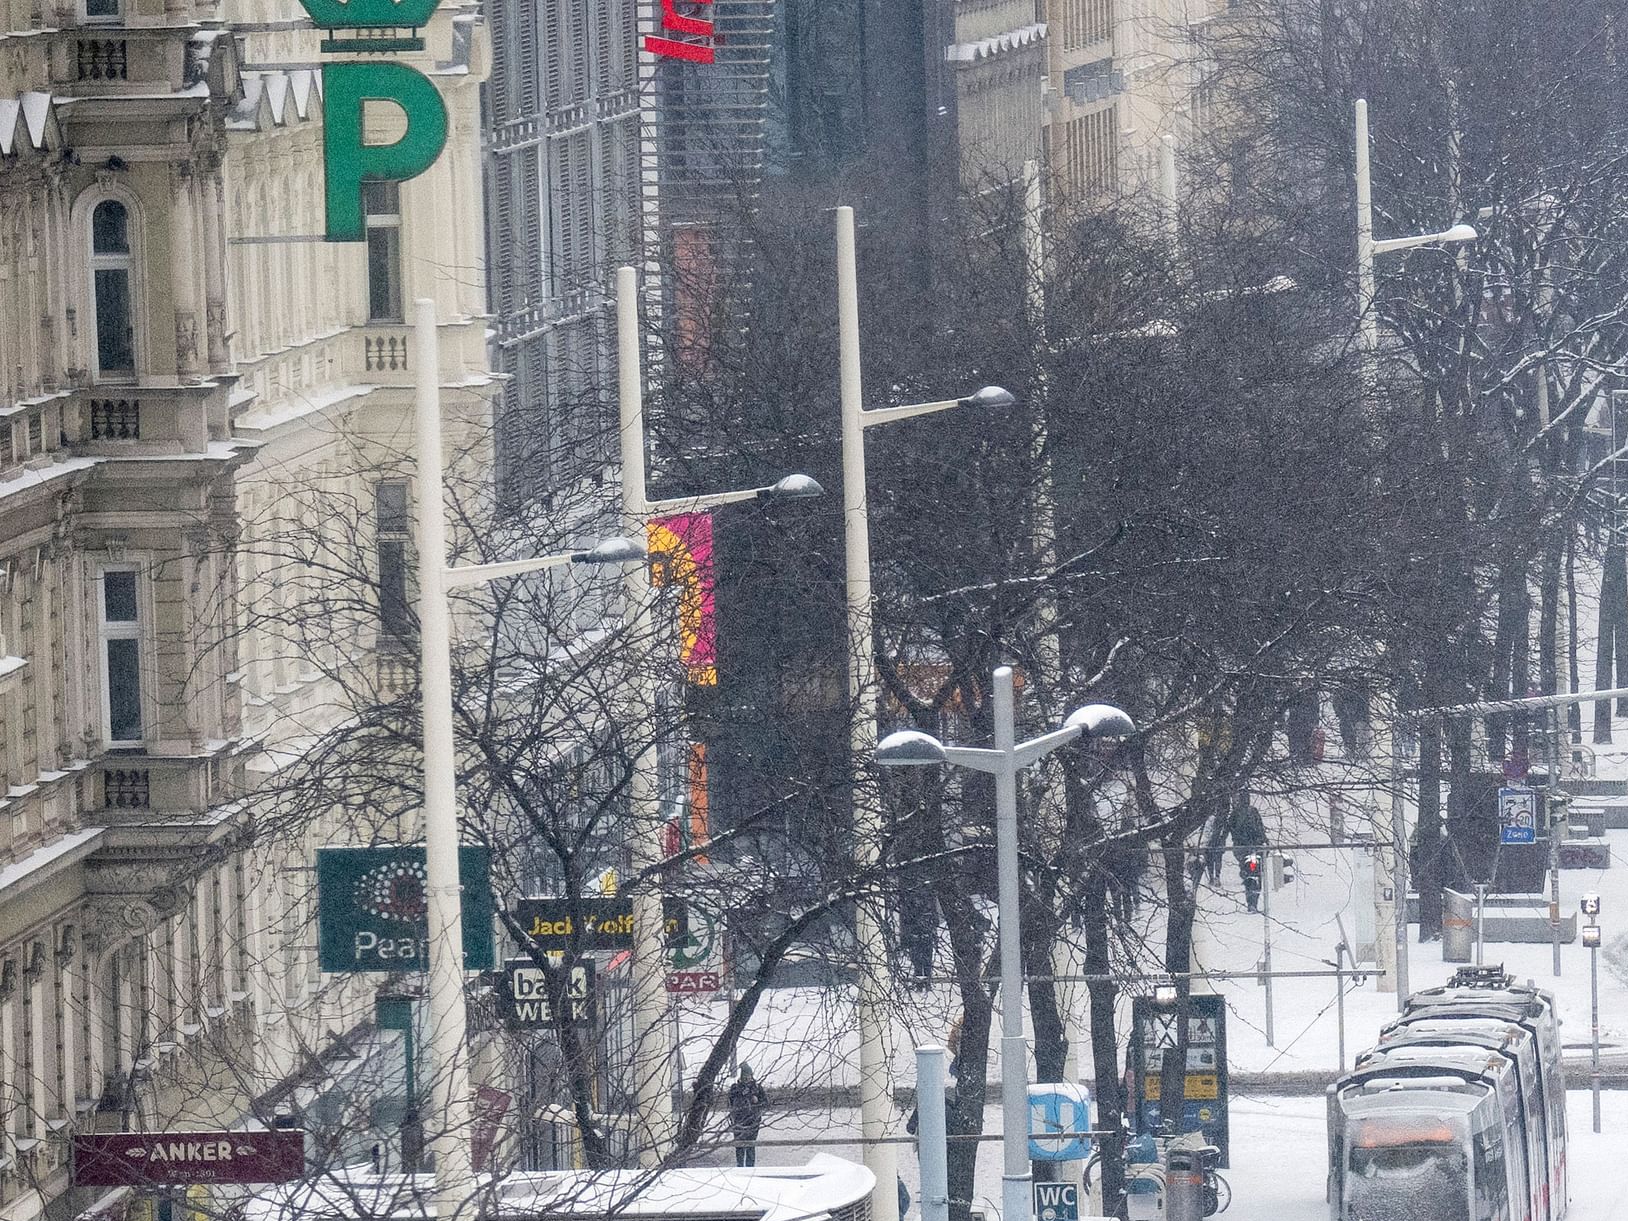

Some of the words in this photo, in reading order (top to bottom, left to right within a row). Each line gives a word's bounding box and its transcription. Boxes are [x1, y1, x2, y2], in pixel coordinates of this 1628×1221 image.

[322, 62, 449, 242] P
[518, 972, 583, 996] bak
[668, 974, 717, 990] PAR
[515, 1001, 588, 1021] WEK
[150, 1140, 233, 1162] ANKER
[1039, 1185, 1075, 1207] WC
